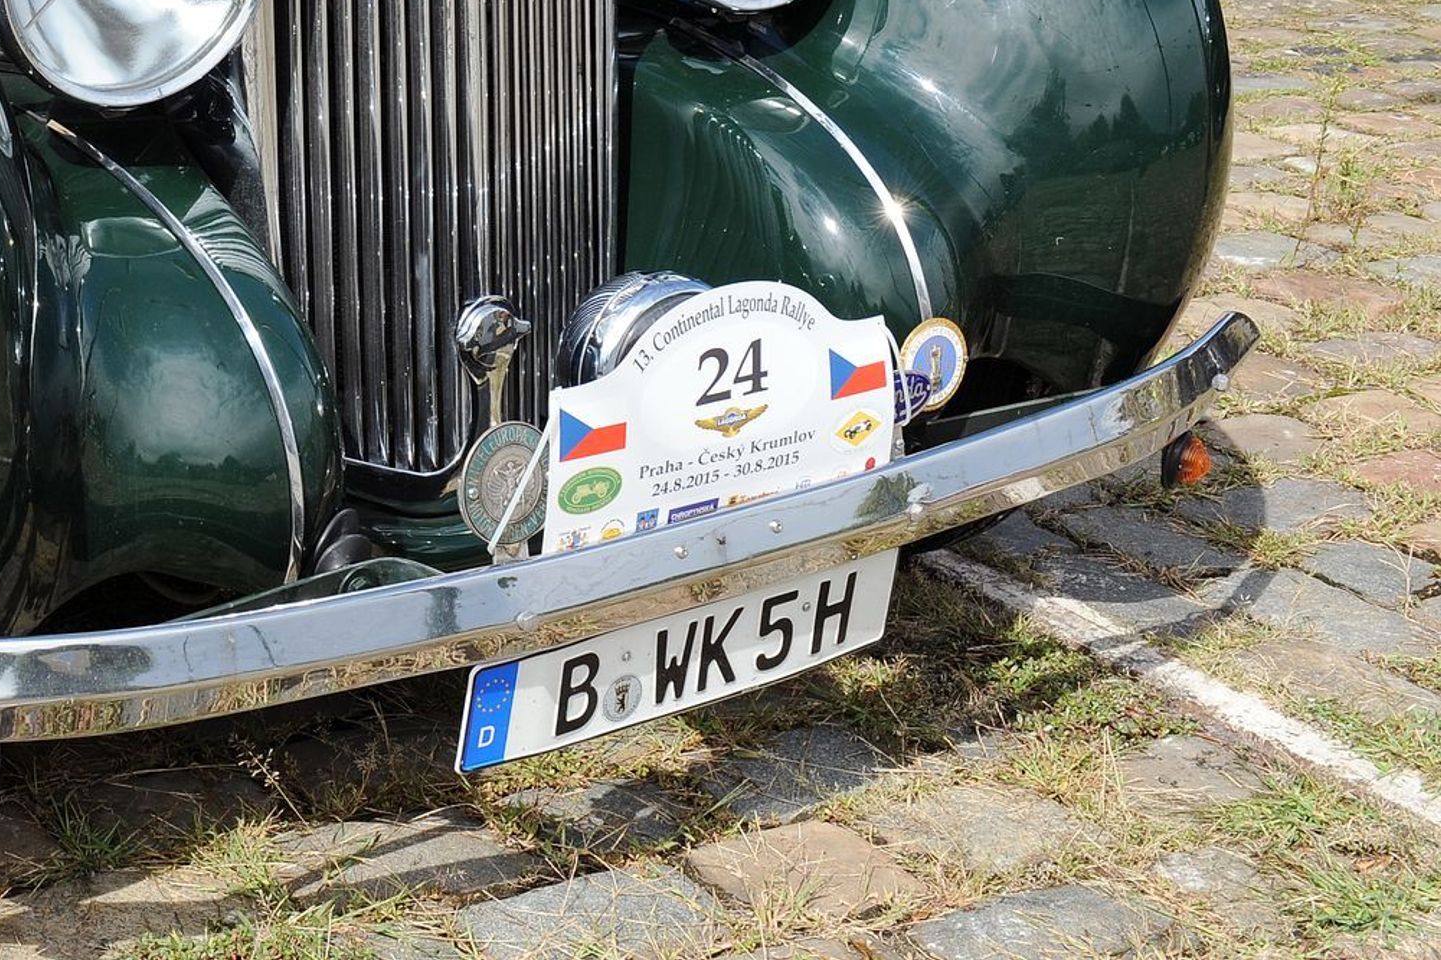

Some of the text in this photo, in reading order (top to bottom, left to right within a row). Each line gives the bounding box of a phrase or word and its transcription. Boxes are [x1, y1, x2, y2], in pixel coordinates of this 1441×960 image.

[633, 292, 816, 373] 13. Continental Lagonda Rallye
[695, 338, 769, 407] 24
[639, 459, 683, 479] Praha
[698, 442, 745, 467] Český
[750, 430, 816, 454] Krumlov
[651, 469, 720, 496] 24.8.2015
[733, 450, 800, 478] 30.8.2015
[555, 652, 600, 736] B
[477, 725, 495, 748] D
